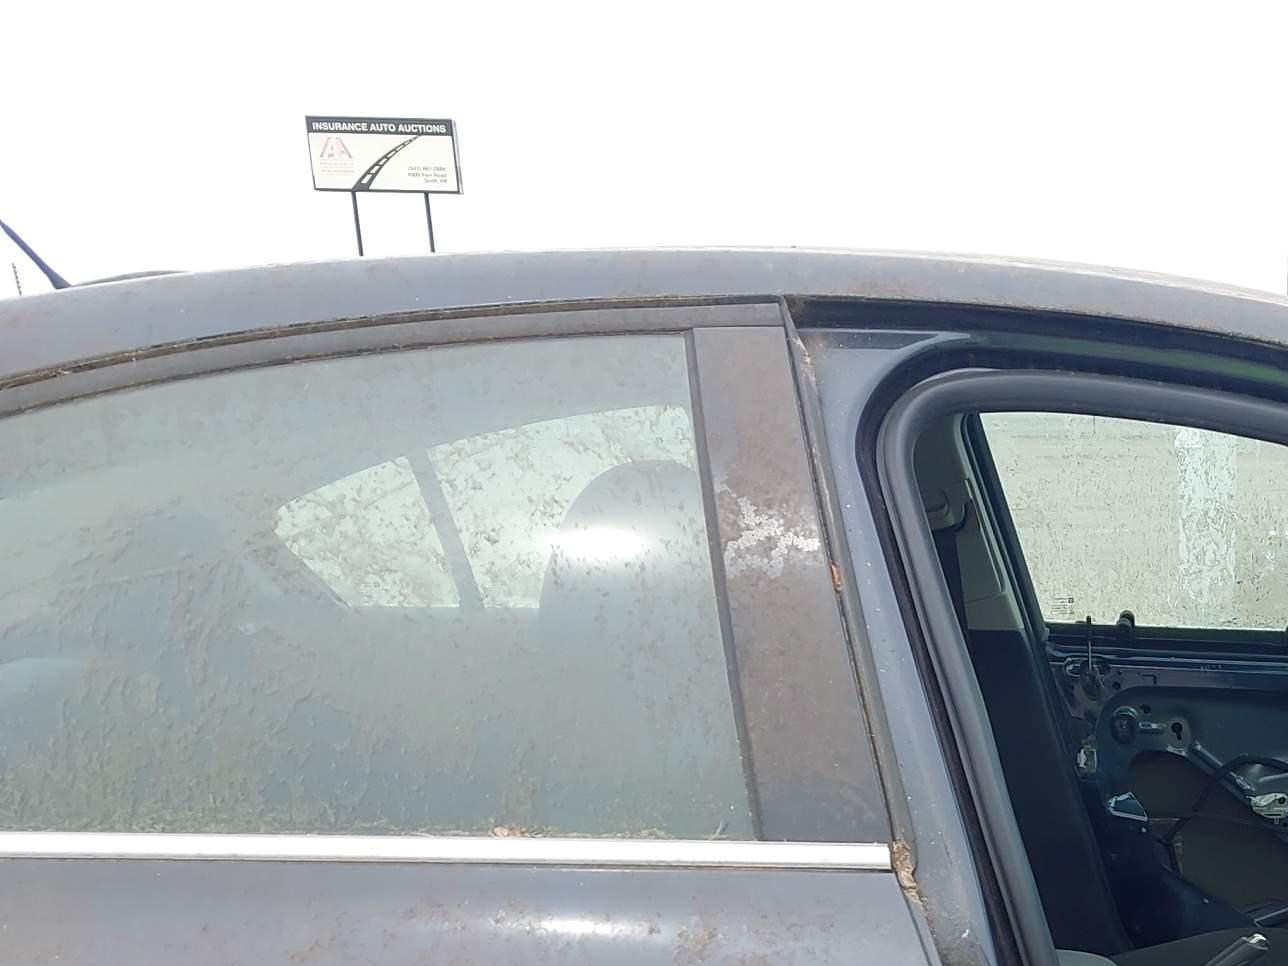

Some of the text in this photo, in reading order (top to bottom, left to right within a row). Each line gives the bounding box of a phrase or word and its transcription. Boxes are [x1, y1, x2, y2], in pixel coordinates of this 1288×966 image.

[312, 122, 446, 133] INSURANCE AUTO AUCTIONS
